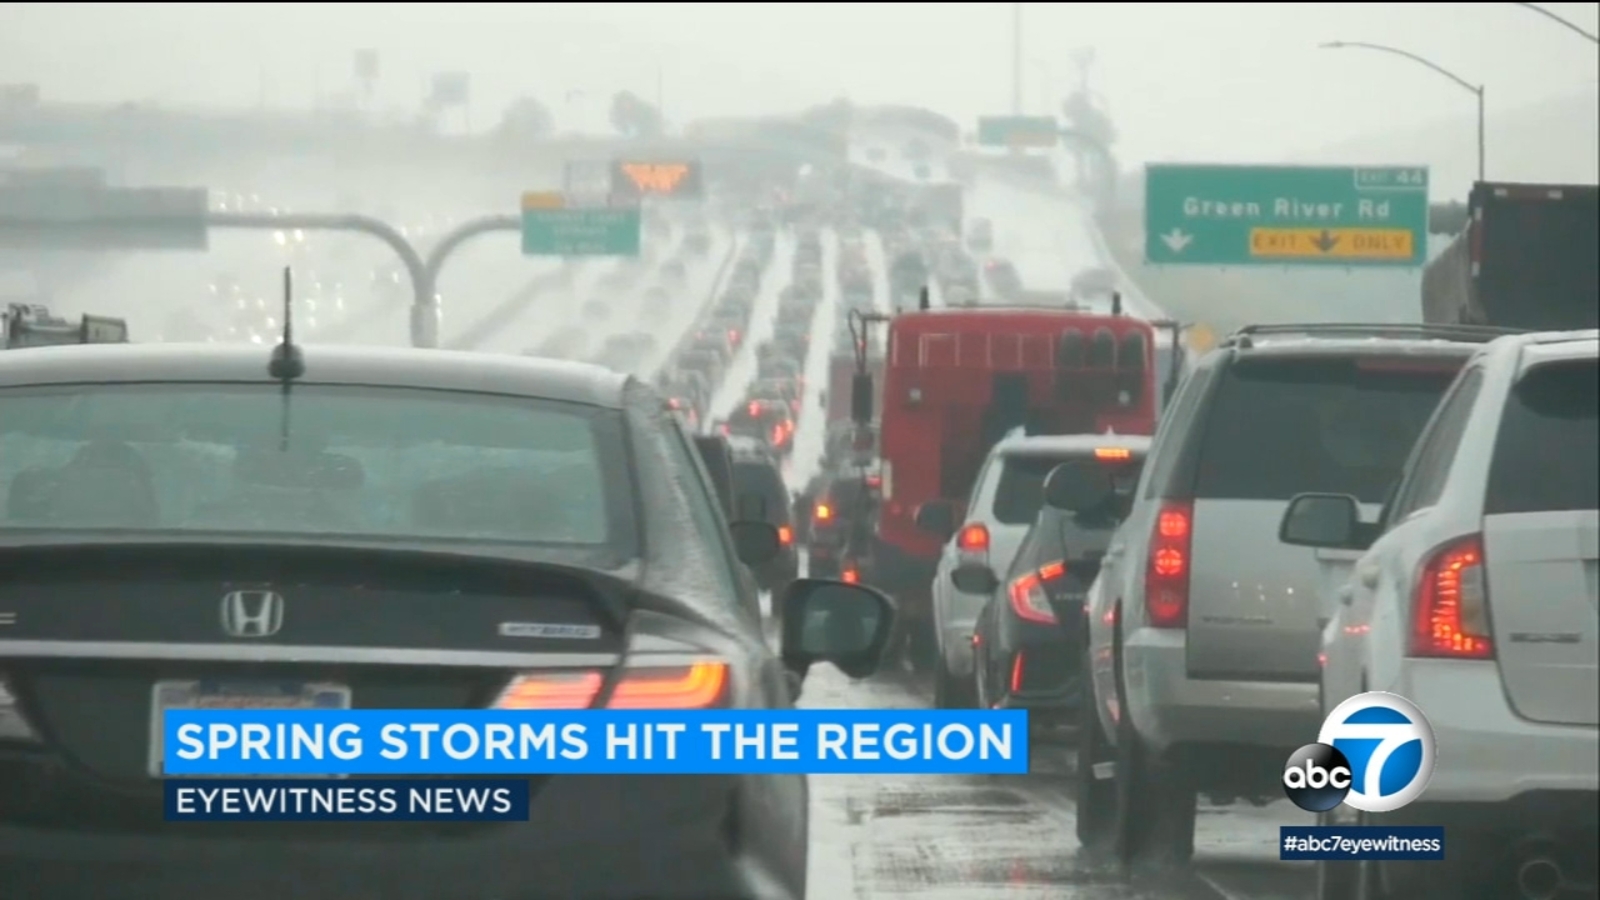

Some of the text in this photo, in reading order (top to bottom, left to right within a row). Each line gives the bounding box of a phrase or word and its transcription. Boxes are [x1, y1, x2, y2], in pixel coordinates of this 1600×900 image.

[1396, 169, 1422, 184] 44
[1184, 197, 1390, 218] Green River Rd
[1253, 231, 1406, 251] EXIT ONLY
